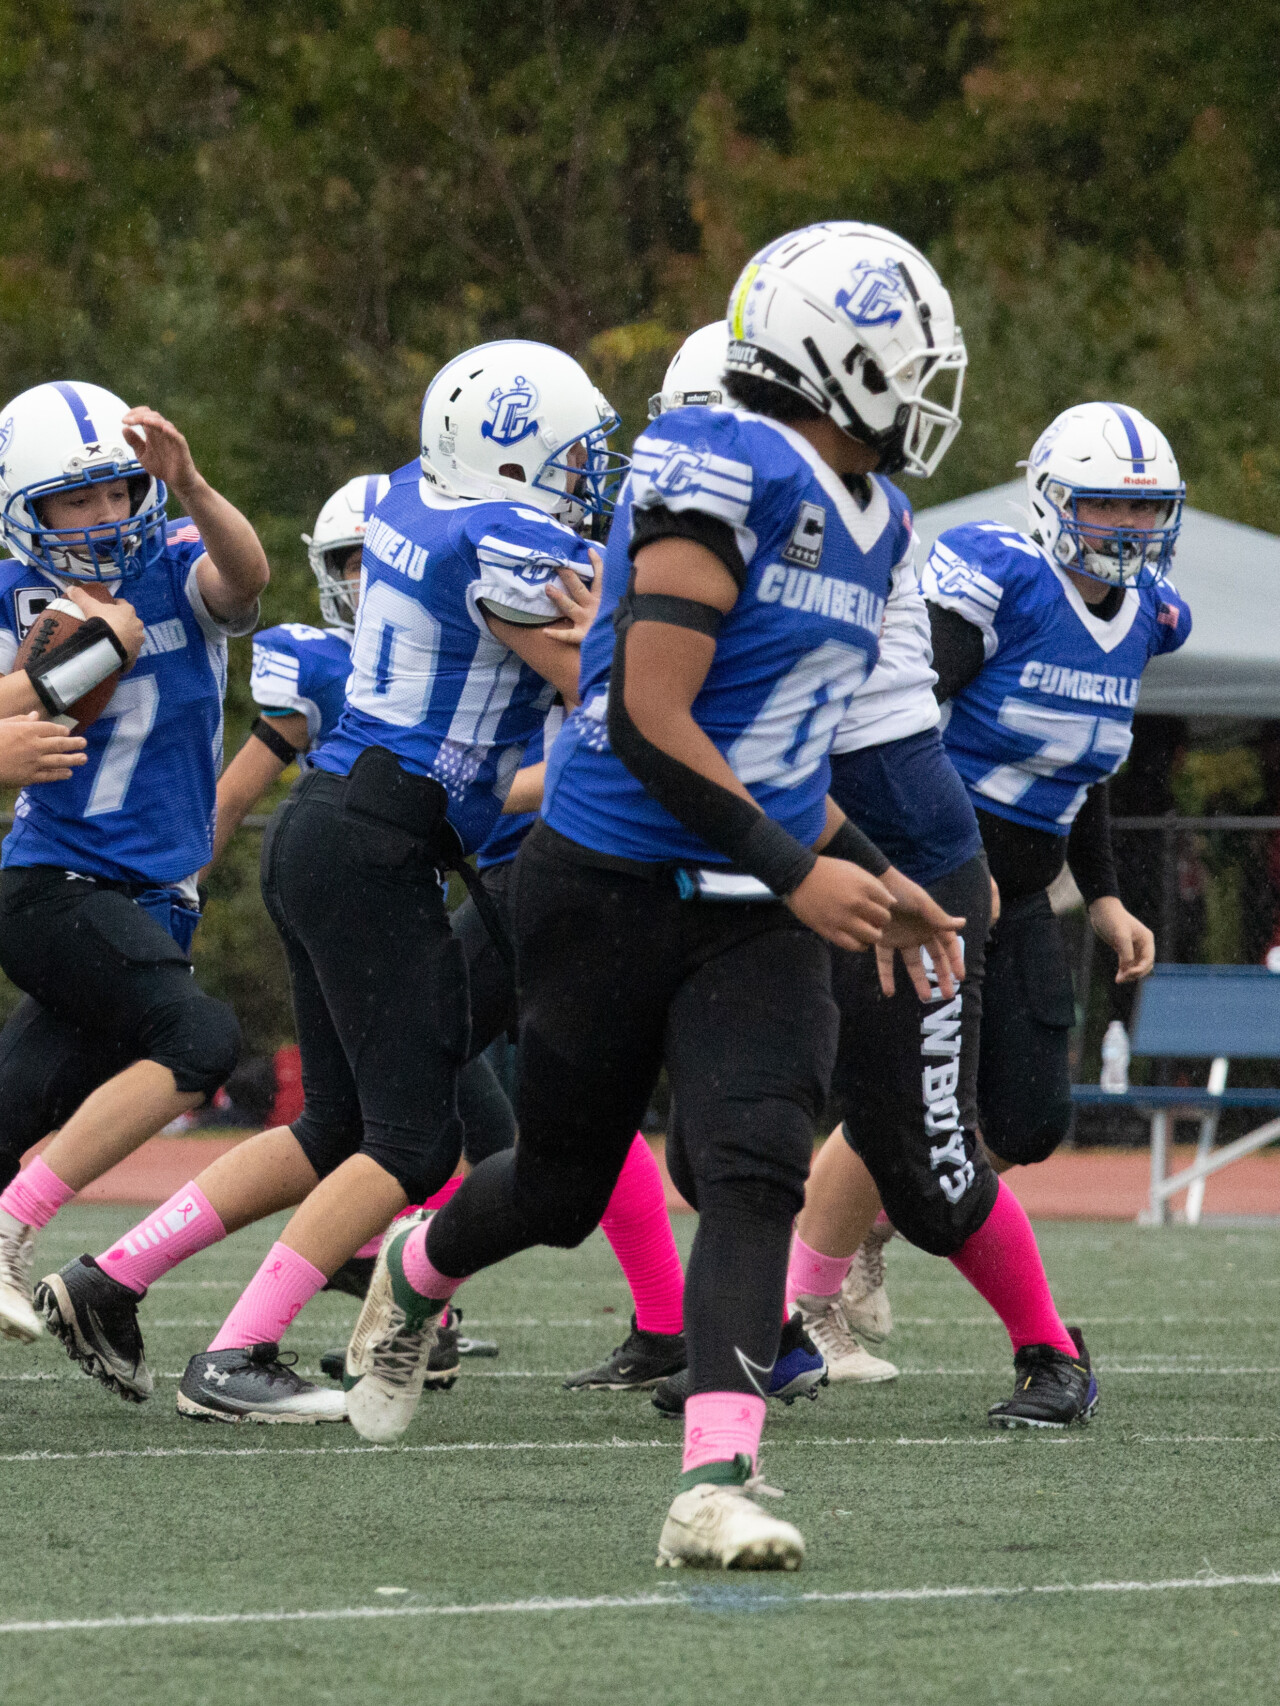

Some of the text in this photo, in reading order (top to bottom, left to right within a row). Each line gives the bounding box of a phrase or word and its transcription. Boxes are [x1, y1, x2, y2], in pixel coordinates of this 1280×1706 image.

[1123, 476, 1157, 485] Riddell
[345, 566, 441, 728] 0
[82, 673, 160, 818] 7
